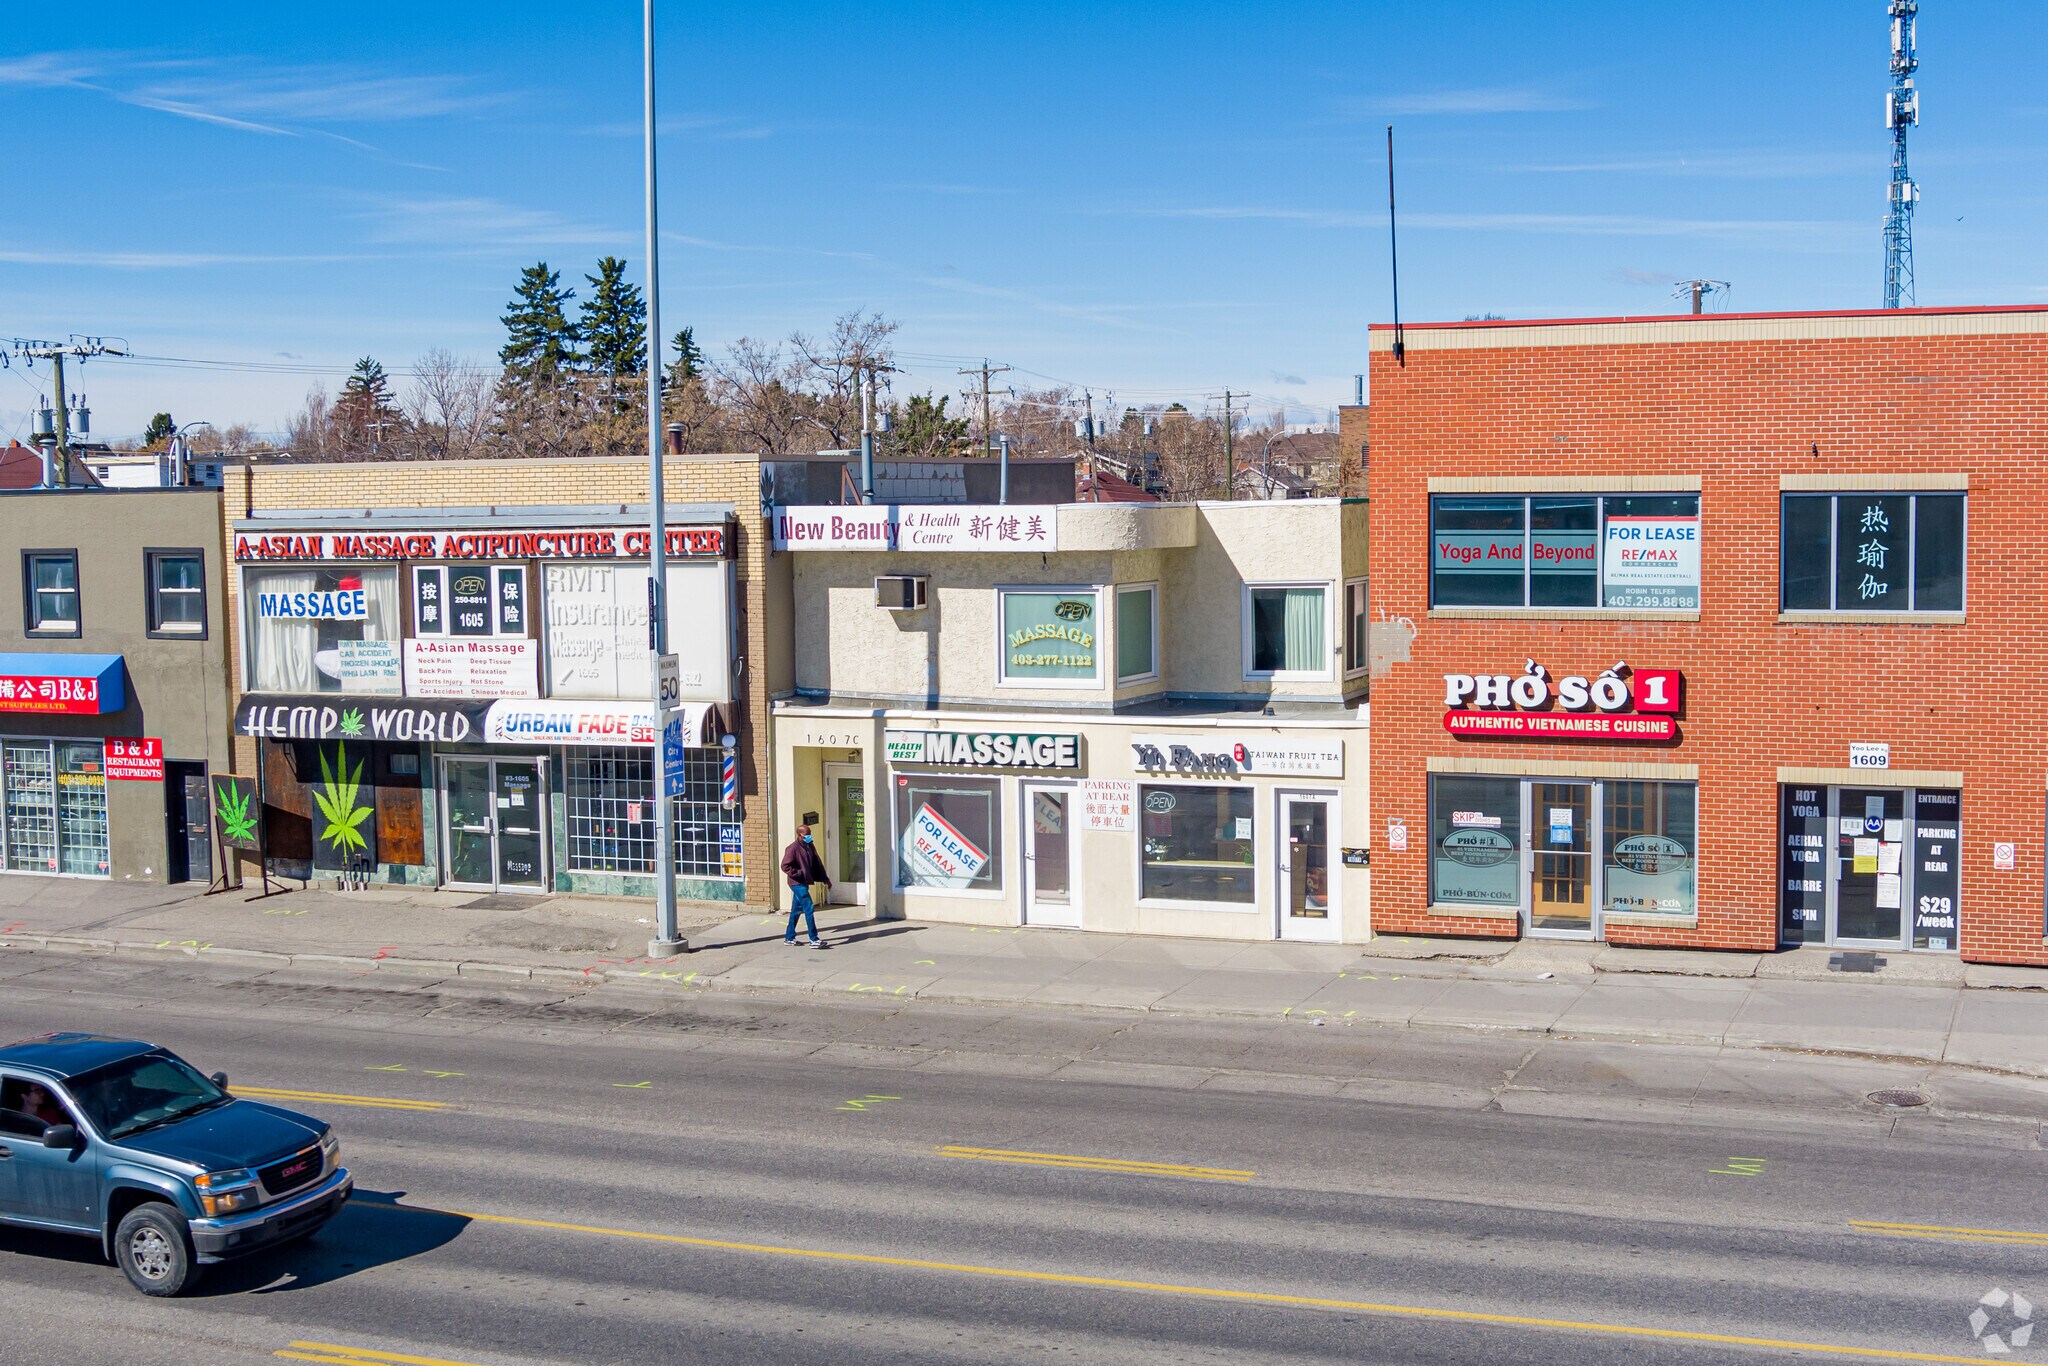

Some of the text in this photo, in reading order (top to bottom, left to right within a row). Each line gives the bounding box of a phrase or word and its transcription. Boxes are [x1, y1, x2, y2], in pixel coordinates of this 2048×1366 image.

[779, 513, 961, 546] New Beauty & Health
[968, 514, 1047, 542] 新健美
[1609, 527, 1695, 540] FOR LEASE
[912, 530, 954, 544] Centre
[235, 536, 322, 557] A-ASIAN
[332, 535, 434, 556] MASSAGE
[441, 532, 614, 556] ACUPUNCTURE
[1439, 543, 1595, 563] Yoga And Beyond
[1622, 549, 1678, 560] RE/MAX
[1857, 506, 1889, 600] 热瑜伽
[454, 579, 486, 592] OPEN
[548, 567, 612, 593] RMT
[260, 590, 366, 618] MASSAGE
[421, 583, 438, 622] 按摩
[454, 596, 487, 604] 250-8811
[503, 583, 520, 623] 保险
[1609, 596, 1694, 607] 403.299.8888
[1055, 602, 1091, 618] OPEN
[460, 613, 484, 627] 1605
[1008, 623, 1093, 650] MASSAGE
[415, 642, 525, 655] A-Asian Massage
[470, 658, 487, 666] Deep
[1011, 653, 1092, 667] 403-277-1122
[58, 679, 98, 701] B&J
[661, 676, 678, 701] 50
[1443, 658, 1669, 710] PHỞ SỐ 1
[242, 706, 470, 743] HEMP WORLD
[505, 713, 629, 734] URBAN FADE
[1450, 716, 1669, 733] AUTHENTIC VIETNAMESE CUISINE
[631, 729, 655, 740] SH
[113, 740, 153, 756] B & J
[667, 747, 679, 757] City
[887, 741, 922, 751] HEALTH
[926, 733, 1076, 766] MASSAGE
[892, 750, 918, 759] BEST
[1250, 751, 1285, 759] TAIWAN
[1288, 752, 1317, 760] FRUIT
[1320, 753, 1339, 761] TEA
[1852, 755, 1886, 765] 1609
[107, 757, 161, 766] RESTAURANT
[665, 759, 683, 769] Centre
[107, 767, 162, 778] EQUIPMENTS
[1084, 780, 1131, 790] PARKING
[1085, 792, 1129, 801] AT REAR
[1146, 793, 1173, 808] OPEN
[1795, 790, 1817, 801] HOT
[1918, 794, 1957, 804] ENTRANCE
[1453, 812, 1475, 822] SKIP
[1792, 805, 1820, 818] YOGA
[1091, 815, 1125, 827] 停車位
[1867, 819, 1880, 827] AA
[721, 828, 740, 838] ATM
[1917, 828, 1957, 839] PARKING
[918, 815, 942, 840] FOR
[941, 836, 978, 871] LEASE
[1788, 835, 1823, 847] AERIAL
[916, 837, 957, 875] RE/MAX
[1930, 845, 1942, 855] AT
[1791, 851, 1820, 863] YOGA
[1924, 862, 1948, 872] REAR
[1788, 880, 1822, 892] BARRE
[1919, 896, 1951, 914] $29
[1792, 908, 1817, 921] SPIN
[1916, 915, 1955, 928] /week
[282, 1161, 307, 1177] GMC
